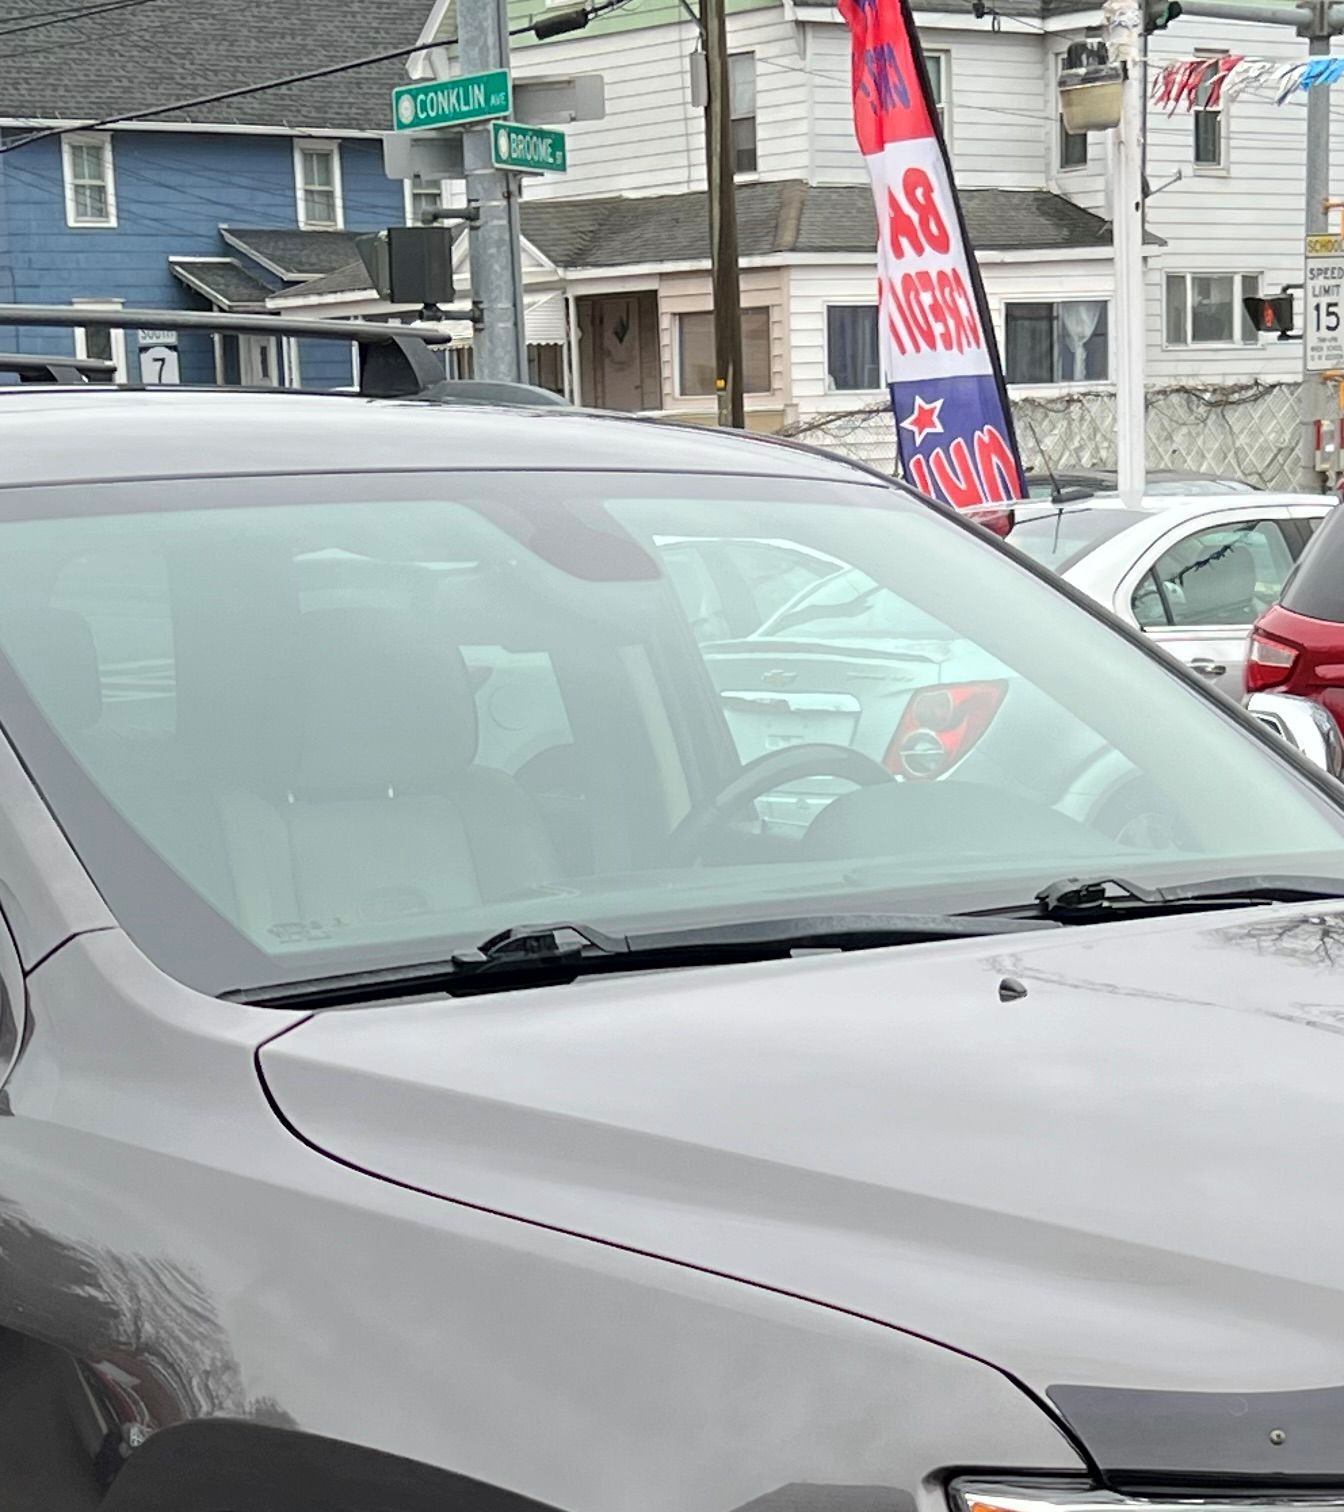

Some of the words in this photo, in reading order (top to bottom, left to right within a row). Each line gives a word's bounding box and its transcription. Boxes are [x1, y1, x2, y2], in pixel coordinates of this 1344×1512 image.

[416, 83, 486, 119] CONKLIN
[489, 91, 506, 107] AVE
[510, 132, 555, 164] BROOME
[1307, 239, 1344, 253] SCHOOL
[1308, 266, 1344, 281] SPEED
[1312, 284, 1341, 298] LIMIT
[1313, 301, 1341, 332] 15
[152, 357, 166, 385] 7
